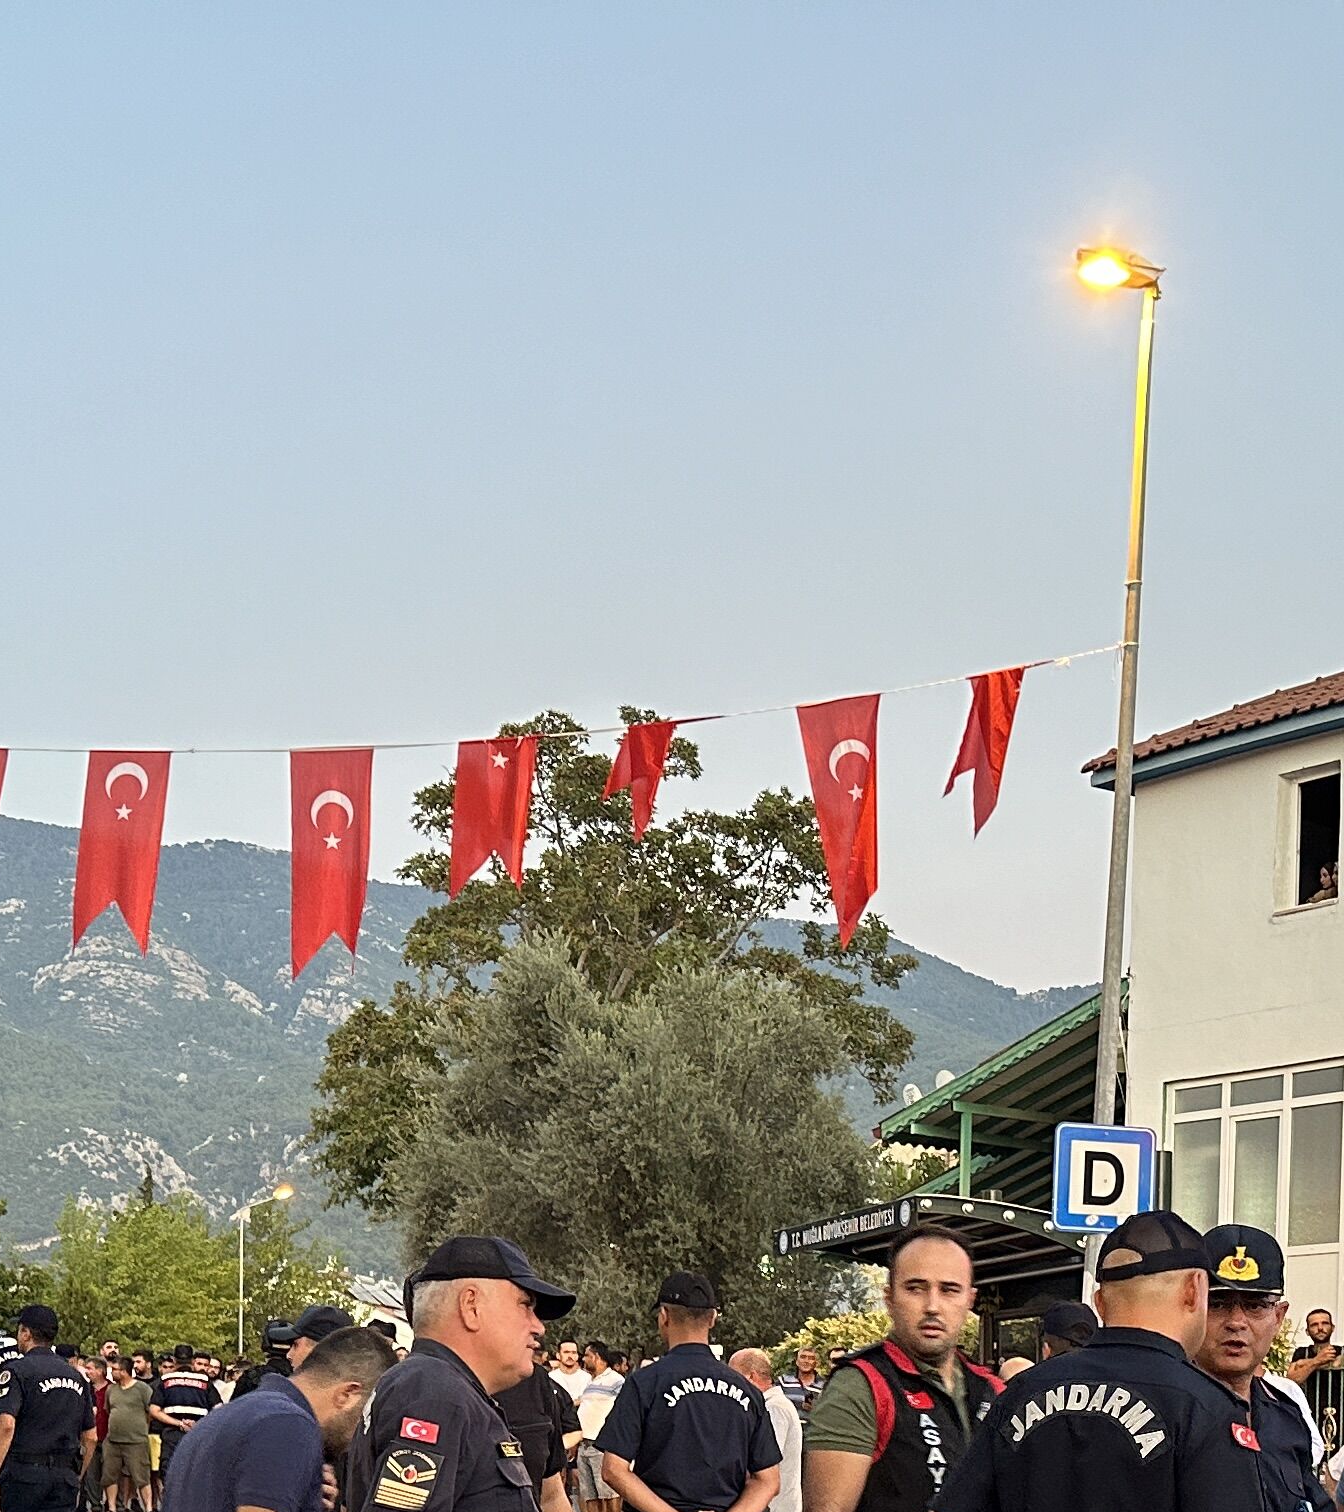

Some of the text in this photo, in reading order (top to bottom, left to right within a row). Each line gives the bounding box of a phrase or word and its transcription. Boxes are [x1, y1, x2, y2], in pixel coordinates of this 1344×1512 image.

[1083, 1151, 1124, 1206] D
[38, 1377, 84, 1396] JANDARMA
[663, 1377, 750, 1411] JANDARMA
[1010, 1384, 1165, 1458] JANDARMA
[919, 1413, 947, 1493] ASAY
